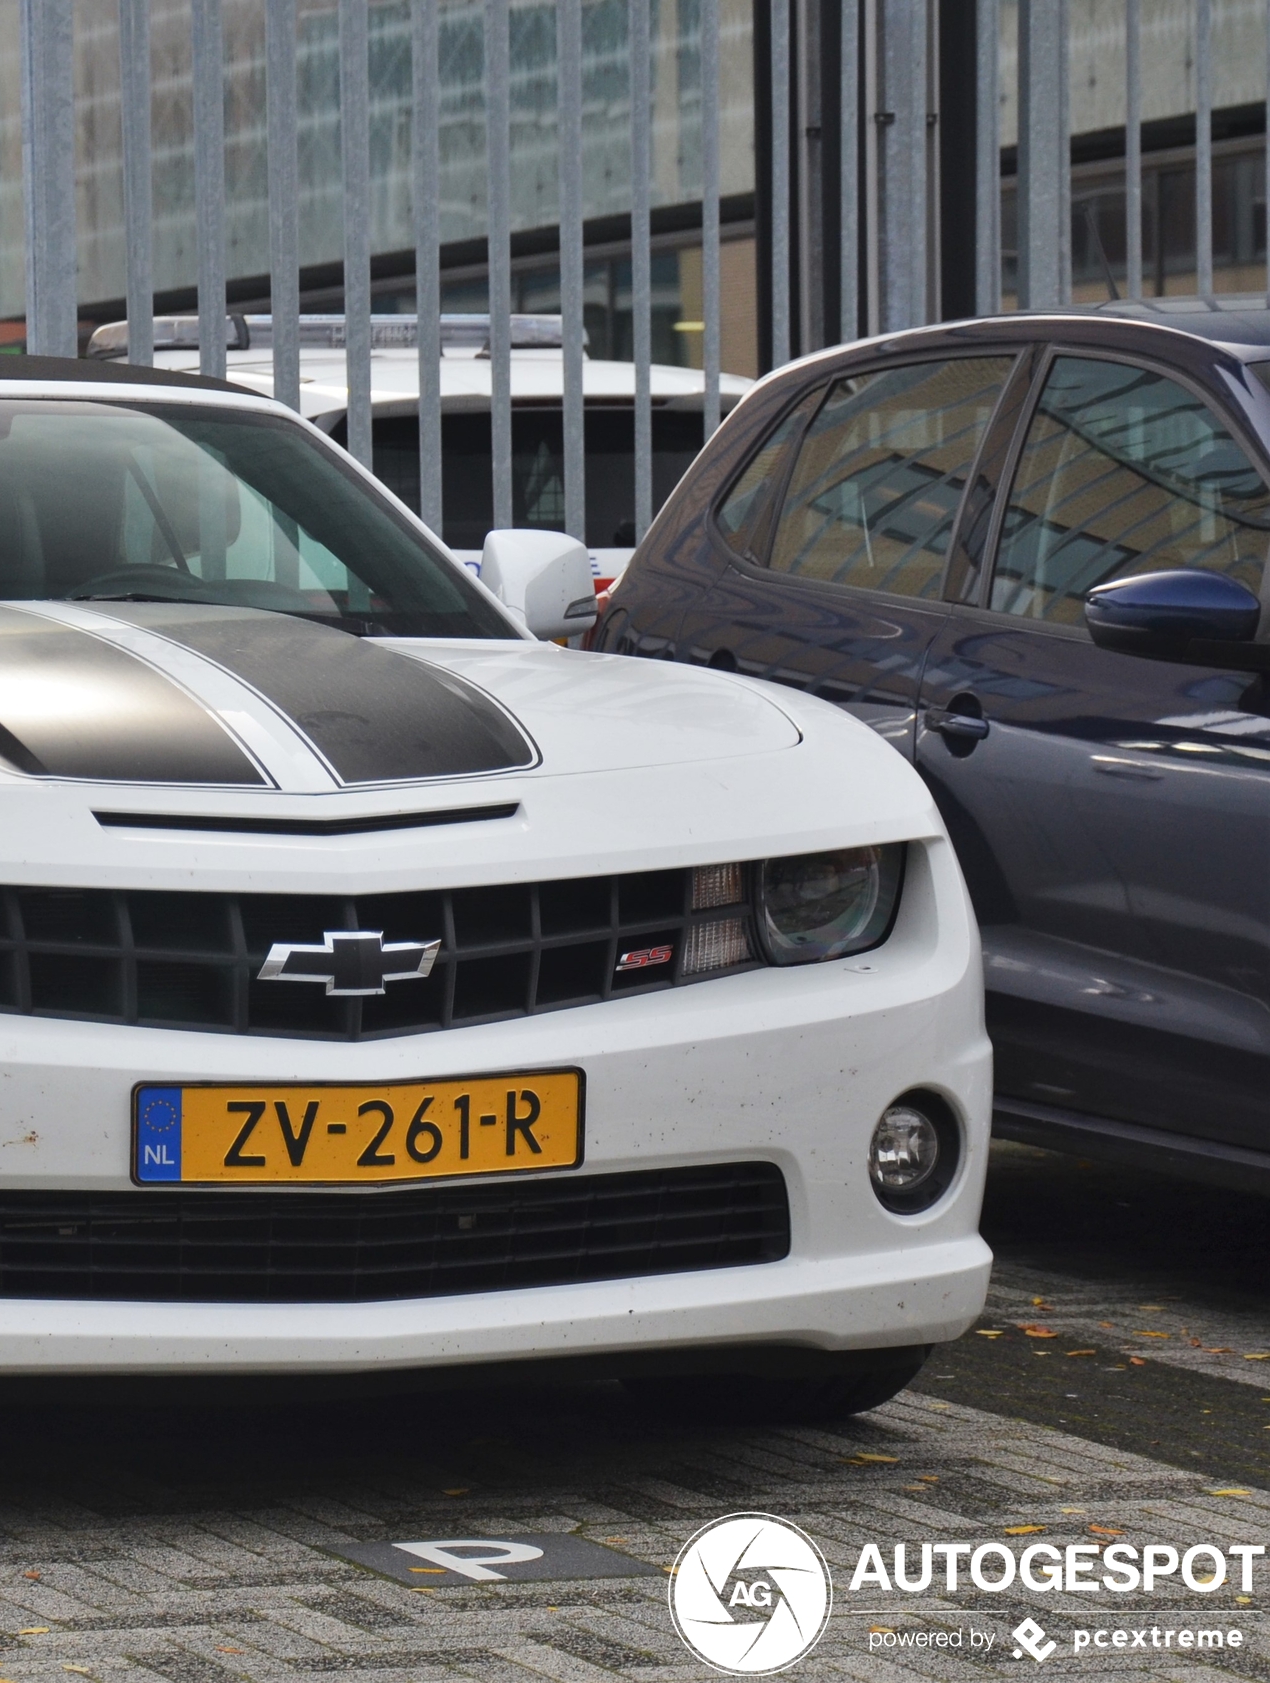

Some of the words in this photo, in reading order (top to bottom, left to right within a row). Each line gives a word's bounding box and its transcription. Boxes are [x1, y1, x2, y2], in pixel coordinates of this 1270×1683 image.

[615, 944, 674, 972] SS
[223, 1089, 543, 1167] ZV-261-R
[144, 1144, 175, 1165] NL
[391, 1540, 544, 1581] P
